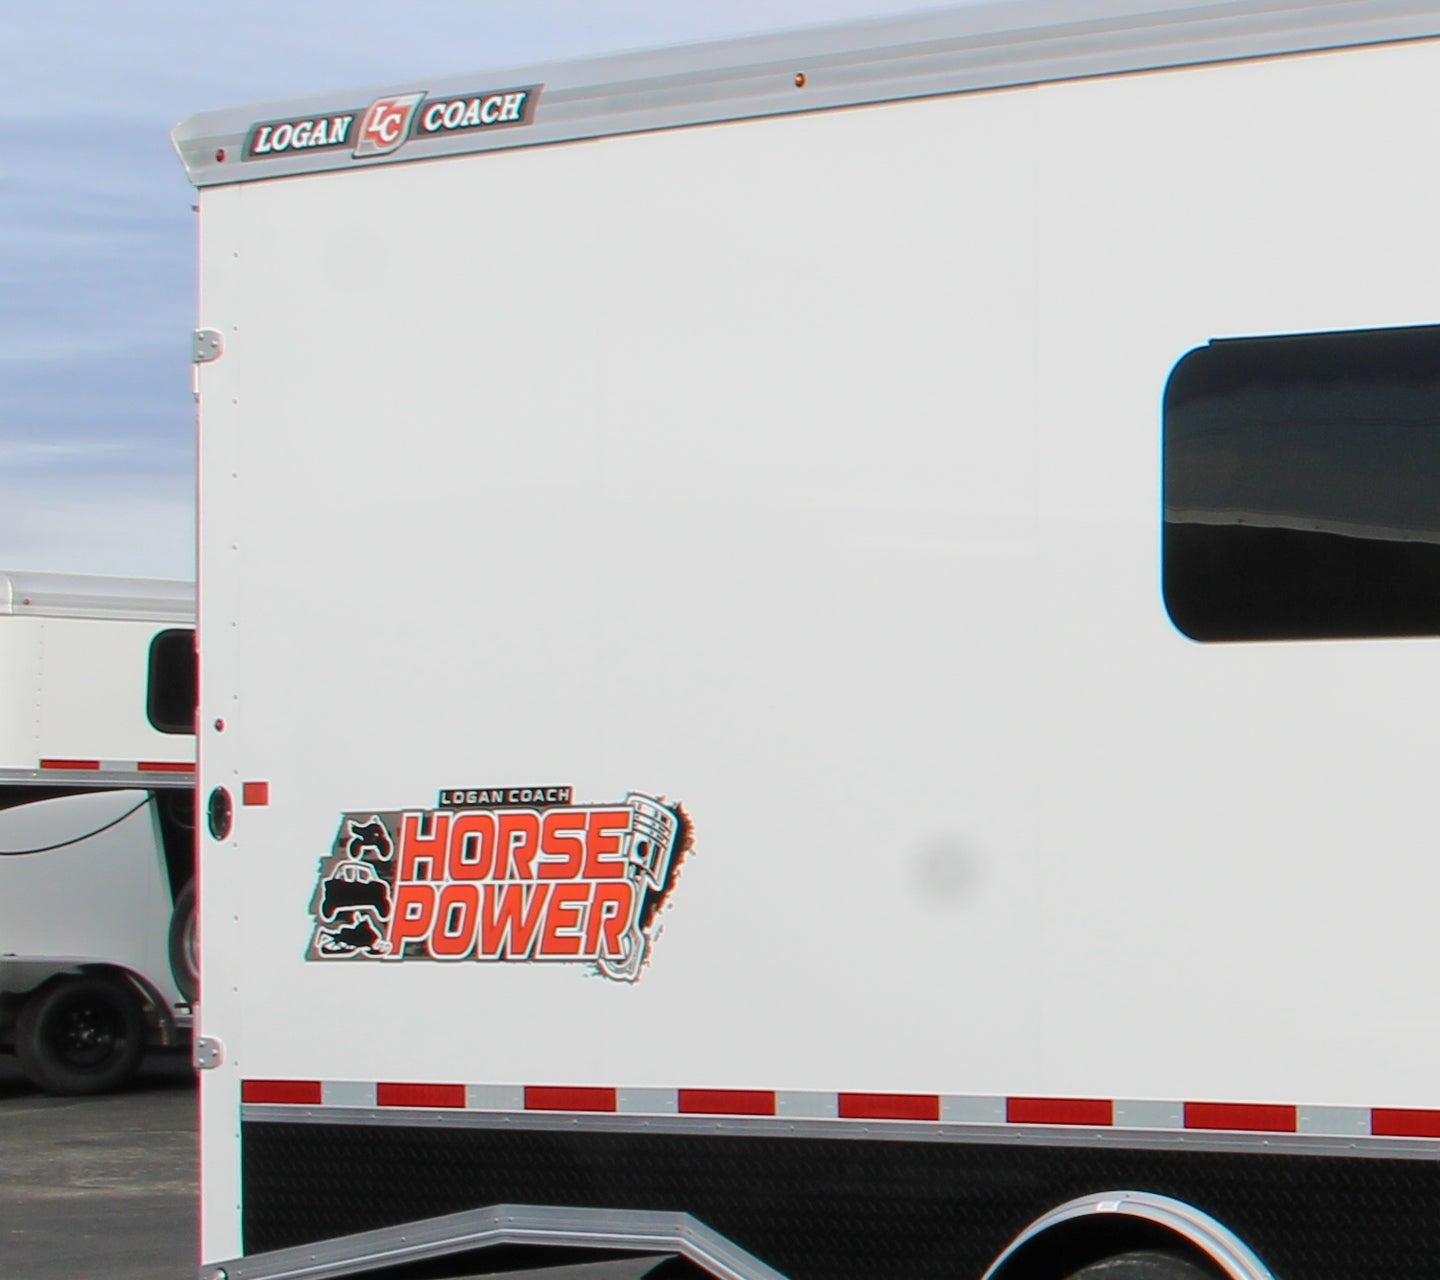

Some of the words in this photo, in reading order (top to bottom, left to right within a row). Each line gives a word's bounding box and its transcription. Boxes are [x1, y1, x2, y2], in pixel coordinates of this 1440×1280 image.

[253, 115, 353, 154] LOGAN
[368, 106, 401, 142] LC
[424, 91, 527, 132] COACH
[441, 790, 504, 805] LOGAN
[508, 788, 570, 803] COACH
[399, 810, 632, 881] HORSE
[391, 881, 632, 956] POWER
